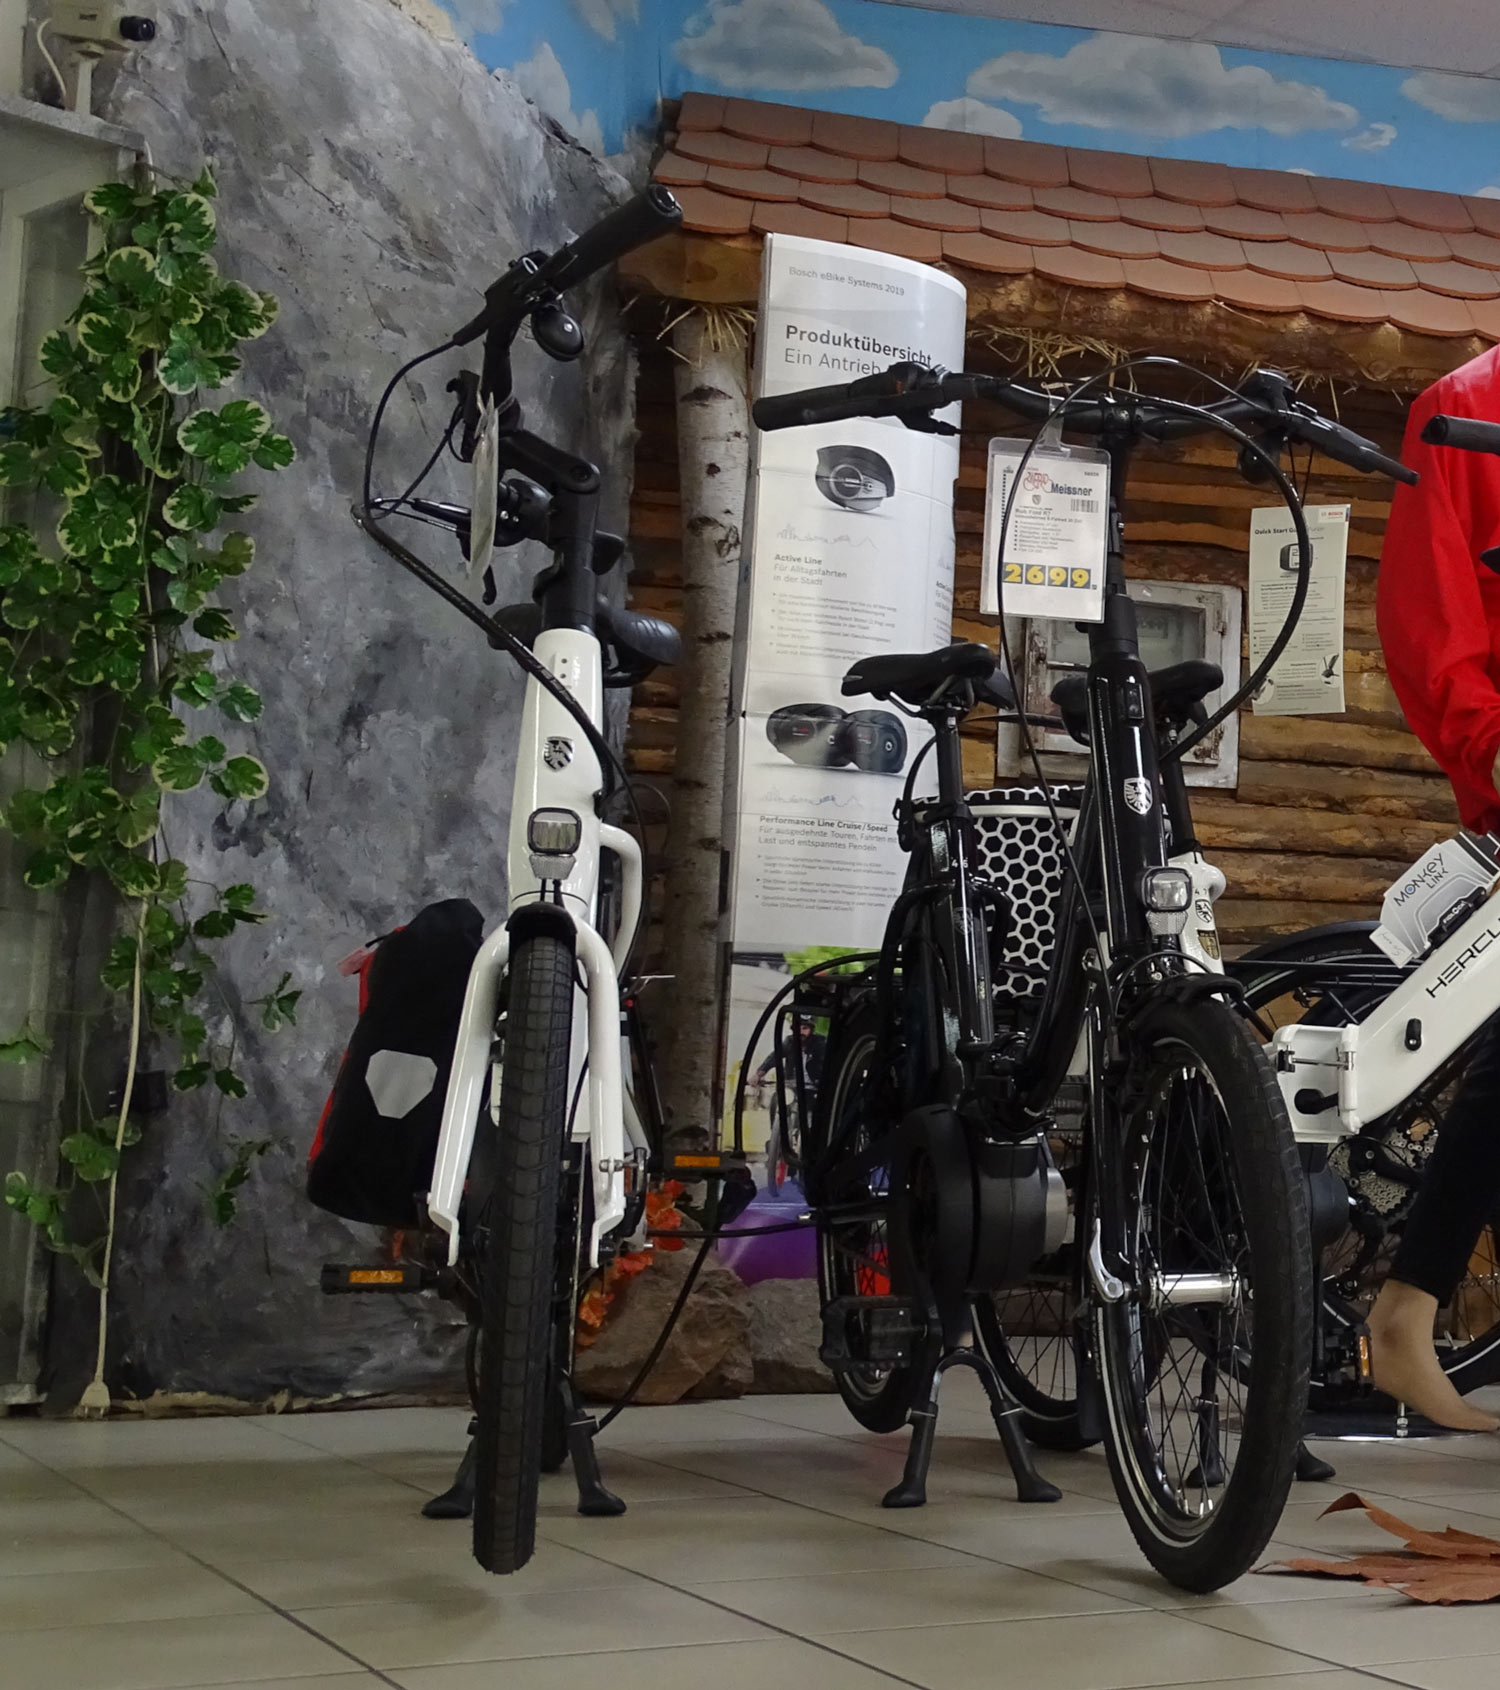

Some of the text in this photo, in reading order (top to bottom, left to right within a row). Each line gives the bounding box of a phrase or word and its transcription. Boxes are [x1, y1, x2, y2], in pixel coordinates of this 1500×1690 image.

[789, 266, 905, 296] Bosch eBike Systems 2019
[786, 325, 932, 368] Produktübersicht
[784, 348, 881, 376] Ein Antrieb
[1051, 482, 1093, 497] Meissner
[775, 553, 823, 566] Active Line
[774, 563, 848, 579] Für Alltagsfahrten
[1004, 563, 1090, 588] 2699
[773, 574, 823, 586] in der Stadt
[760, 816, 816, 827] Performance
[818, 819, 835, 828] Line
[837, 821, 861, 830] Cruise
[867, 824, 888, 832] Speed
[759, 826, 772, 834] Für
[775, 828, 828, 839] ausgedehnte
[759, 837, 776, 845] Last
[779, 838, 795, 846] und
[797, 839, 846, 850] entspanntes
